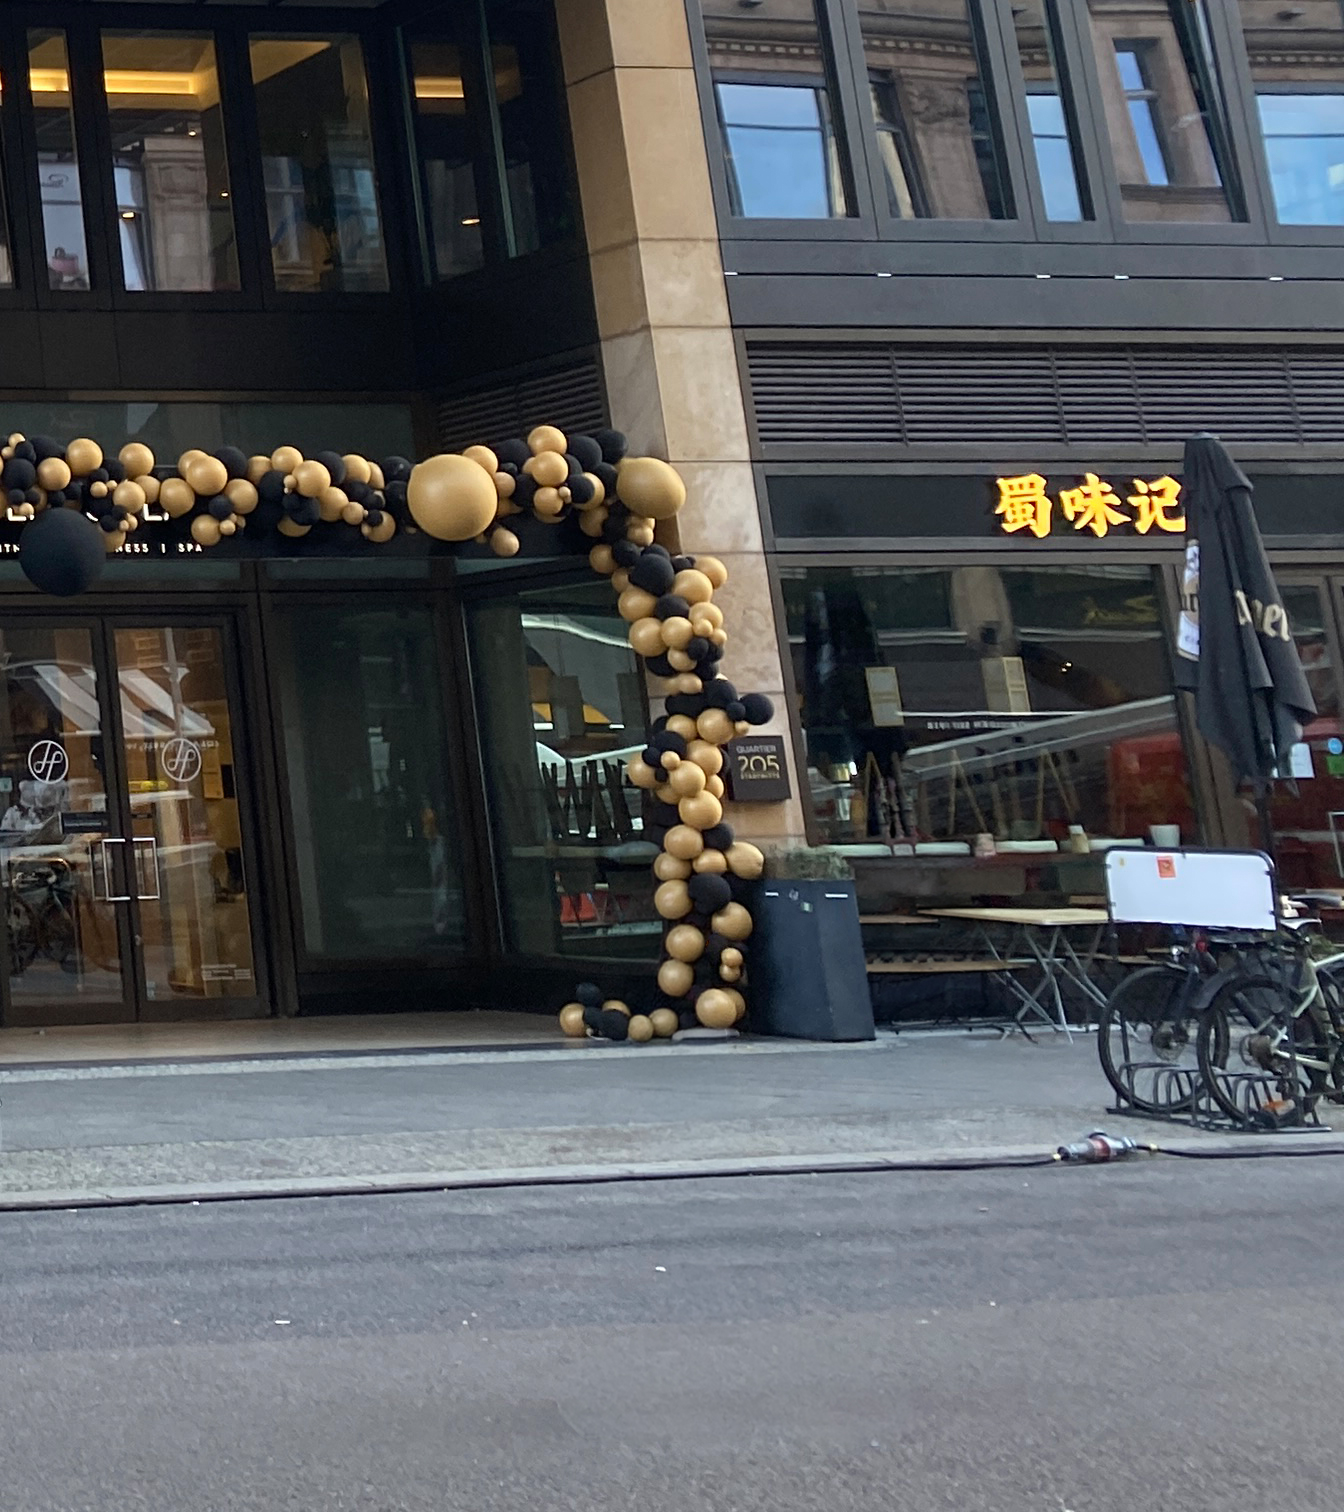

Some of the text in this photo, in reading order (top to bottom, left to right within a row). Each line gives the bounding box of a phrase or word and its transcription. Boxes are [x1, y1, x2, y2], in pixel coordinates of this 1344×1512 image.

[995, 472, 1186, 538] 蜀味记
[178, 543, 203, 554] SPA
